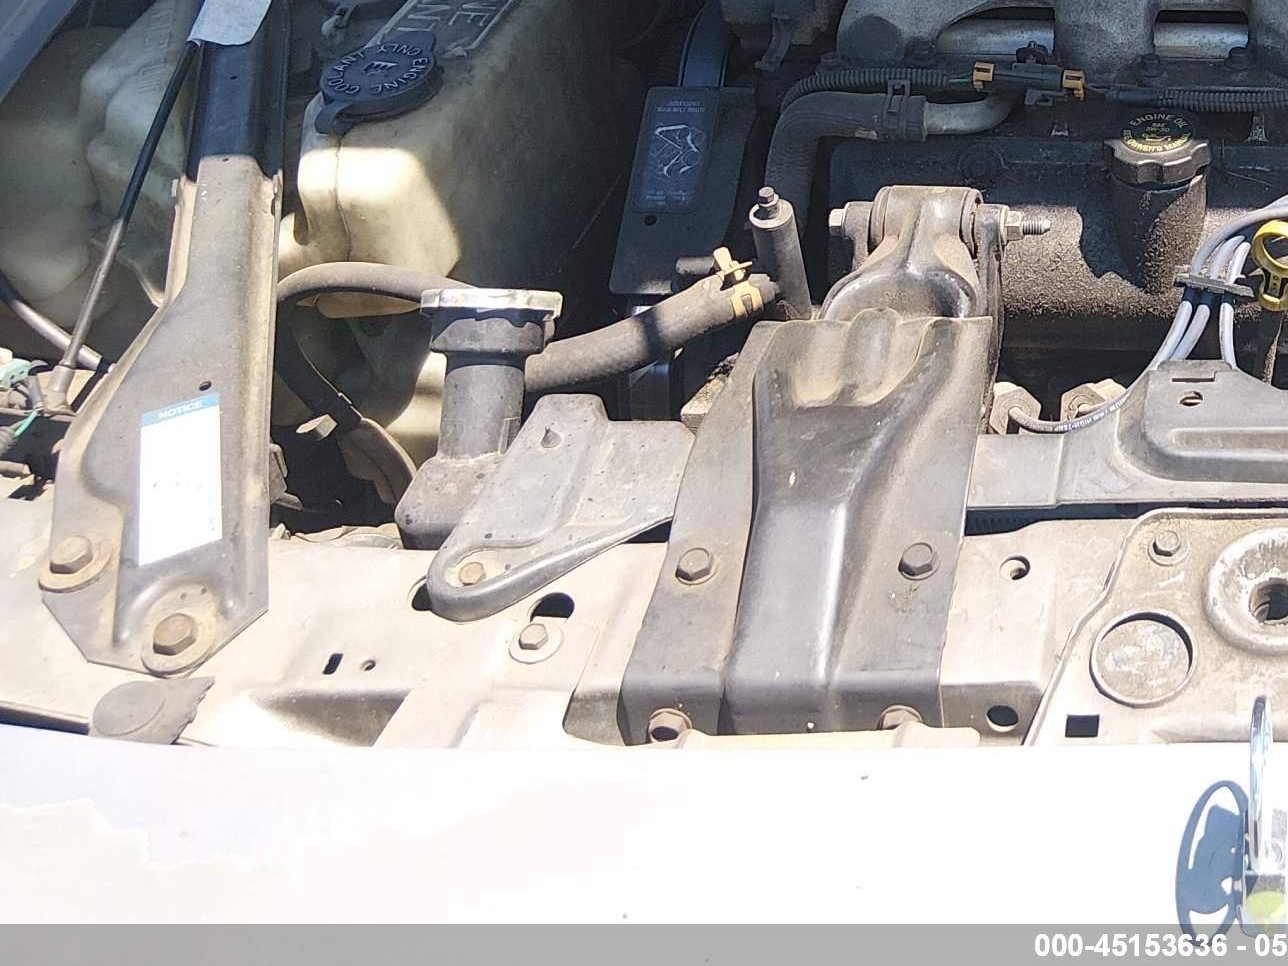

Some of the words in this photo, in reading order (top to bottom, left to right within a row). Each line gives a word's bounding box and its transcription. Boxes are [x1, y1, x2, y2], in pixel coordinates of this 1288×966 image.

[378, 41, 421, 57] ONLY
[327, 50, 366, 95] COOLANT
[373, 56, 430, 93] ENGINE
[1129, 113, 1173, 127] ENGINE
[1173, 117, 1189, 128] OIL
[158, 399, 204, 419] NOTICE
